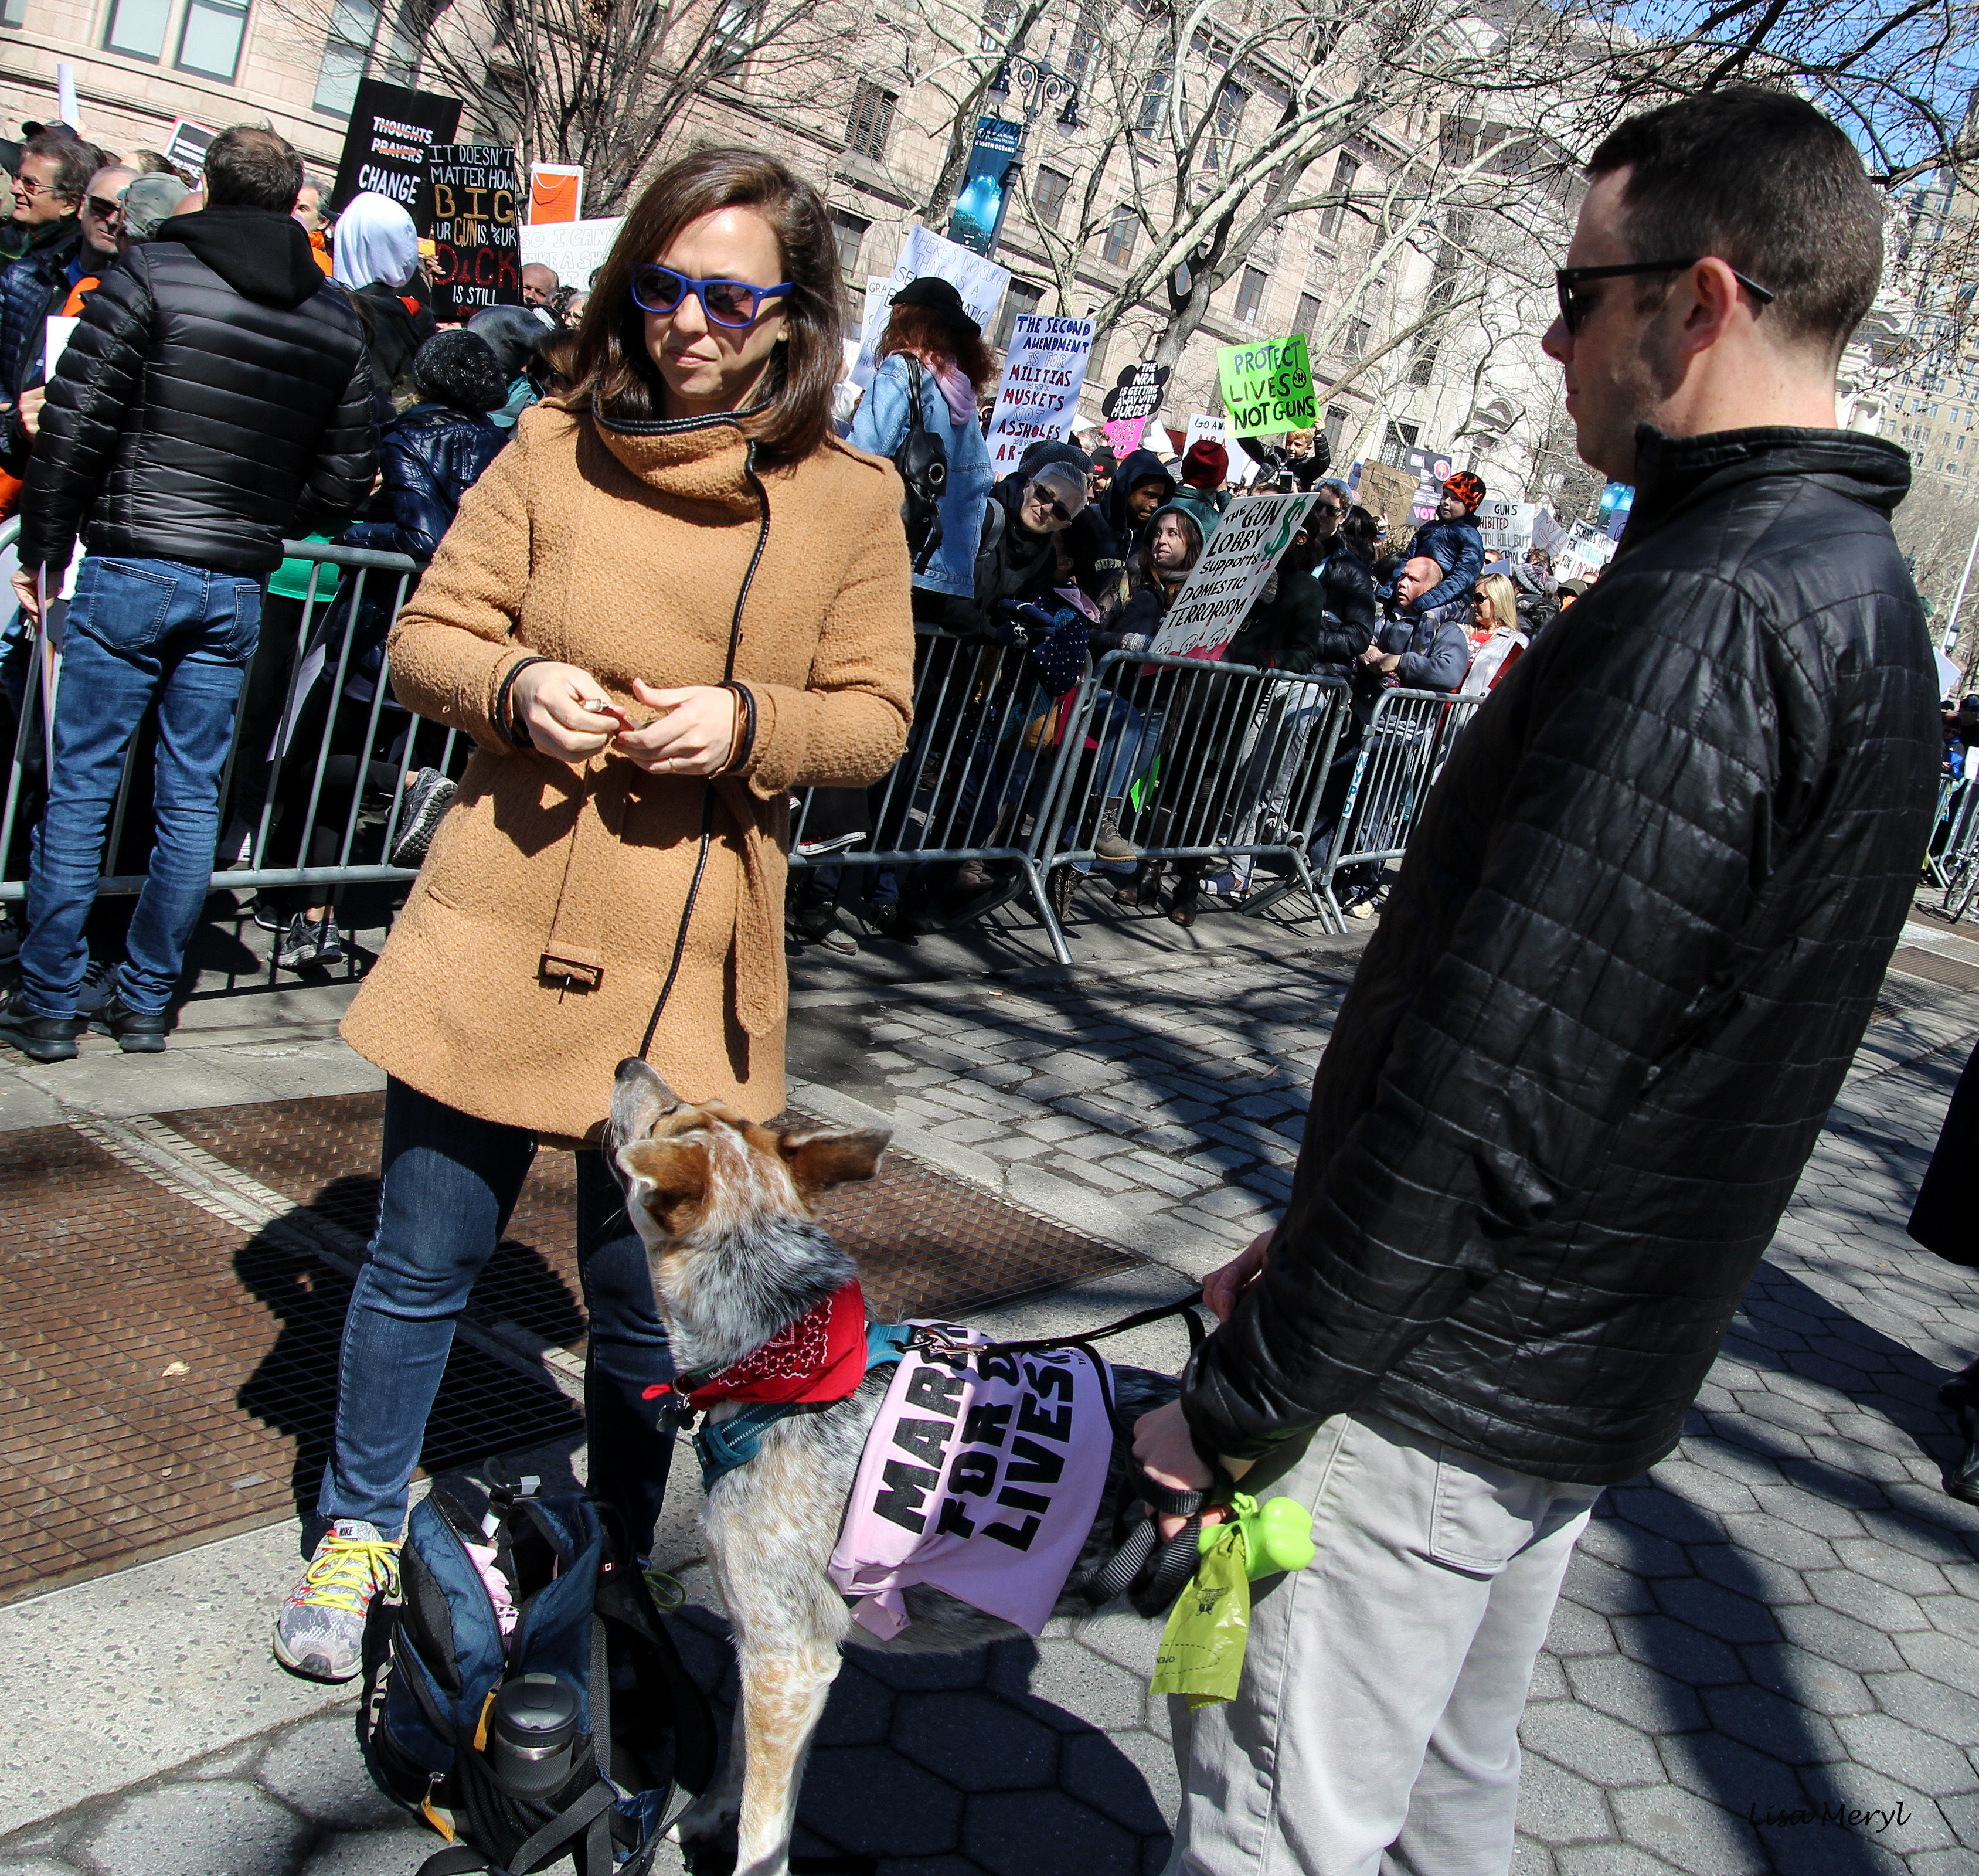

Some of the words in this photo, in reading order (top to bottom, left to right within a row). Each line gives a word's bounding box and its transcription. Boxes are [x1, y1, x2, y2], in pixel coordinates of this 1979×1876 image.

[373, 116, 434, 145] THOUGHTS
[370, 137, 424, 164] PRAYERS
[429, 145, 454, 162] IT
[459, 145, 514, 167] DOESN'T
[359, 164, 421, 205] CHANGE
[430, 166, 485, 188] MATTER
[488, 168, 514, 191] HOW
[434, 183, 515, 227] BIG
[436, 221, 451, 240] UR
[454, 217, 477, 247] GUN
[501, 227, 517, 247] UR
[521, 231, 545, 249] SO
[553, 229, 565, 248] I
[570, 225, 615, 247] CAN'
[560, 251, 574, 269] A
[912, 227, 959, 264] THERE'S
[961, 254, 980, 274] NO
[980, 265, 1007, 288] SUCH
[914, 251, 947, 279] THING
[951, 273, 967, 290] AS
[970, 285, 980, 299] A
[453, 285, 464, 303] IS
[467, 286, 500, 307] STILL
[1016, 315, 1042, 334] THE
[1045, 317, 1091, 337] SECOND
[1022, 336, 1089, 354] AMENDMENT
[1026, 351, 1040, 366] IS
[1044, 352, 1067, 368] FOR
[1142, 362, 1158, 372] THE
[1234, 340, 1300, 375] PROTECT
[1008, 364, 1072, 388] MILITIAS
[1132, 373, 1155, 385] NRA
[1230, 373, 1290, 402] LIVES
[1002, 388, 1065, 412] MUSKETS
[1114, 396, 1140, 407] AWAY
[1138, 393, 1158, 405] WITH
[1119, 386, 1127, 396] IS
[1127, 384, 1159, 396] GETTING
[1012, 407, 1045, 423] NOT
[1110, 403, 1152, 418] MURDER
[1234, 402, 1270, 430] NOT
[1273, 395, 1316, 421] GUNS
[997, 417, 1061, 440] ASSHOLES
[1195, 417, 1210, 429] GO
[995, 443, 1023, 461] AR-
[1369, 467, 1407, 497] LIVES
[1223, 504, 1247, 525] THE
[1241, 498, 1287, 528] GUN
[1361, 491, 1400, 517] BRIBES
[1413, 506, 1440, 521] VOT
[1494, 504, 1518, 515] GUNS
[1206, 528, 1269, 558] LOBBY
[1514, 534, 1531, 549] BUT
[1199, 551, 1261, 577] supports
[1179, 576, 1247, 605] DOMESTIC
[1167, 597, 1247, 630] TERRORISM
[1343, 754, 1369, 814] NYPD
[981, 1361, 1074, 1552] LIVES
[934, 1402, 1014, 1540] FOR
[340, 1526, 355, 1537] NIKE
